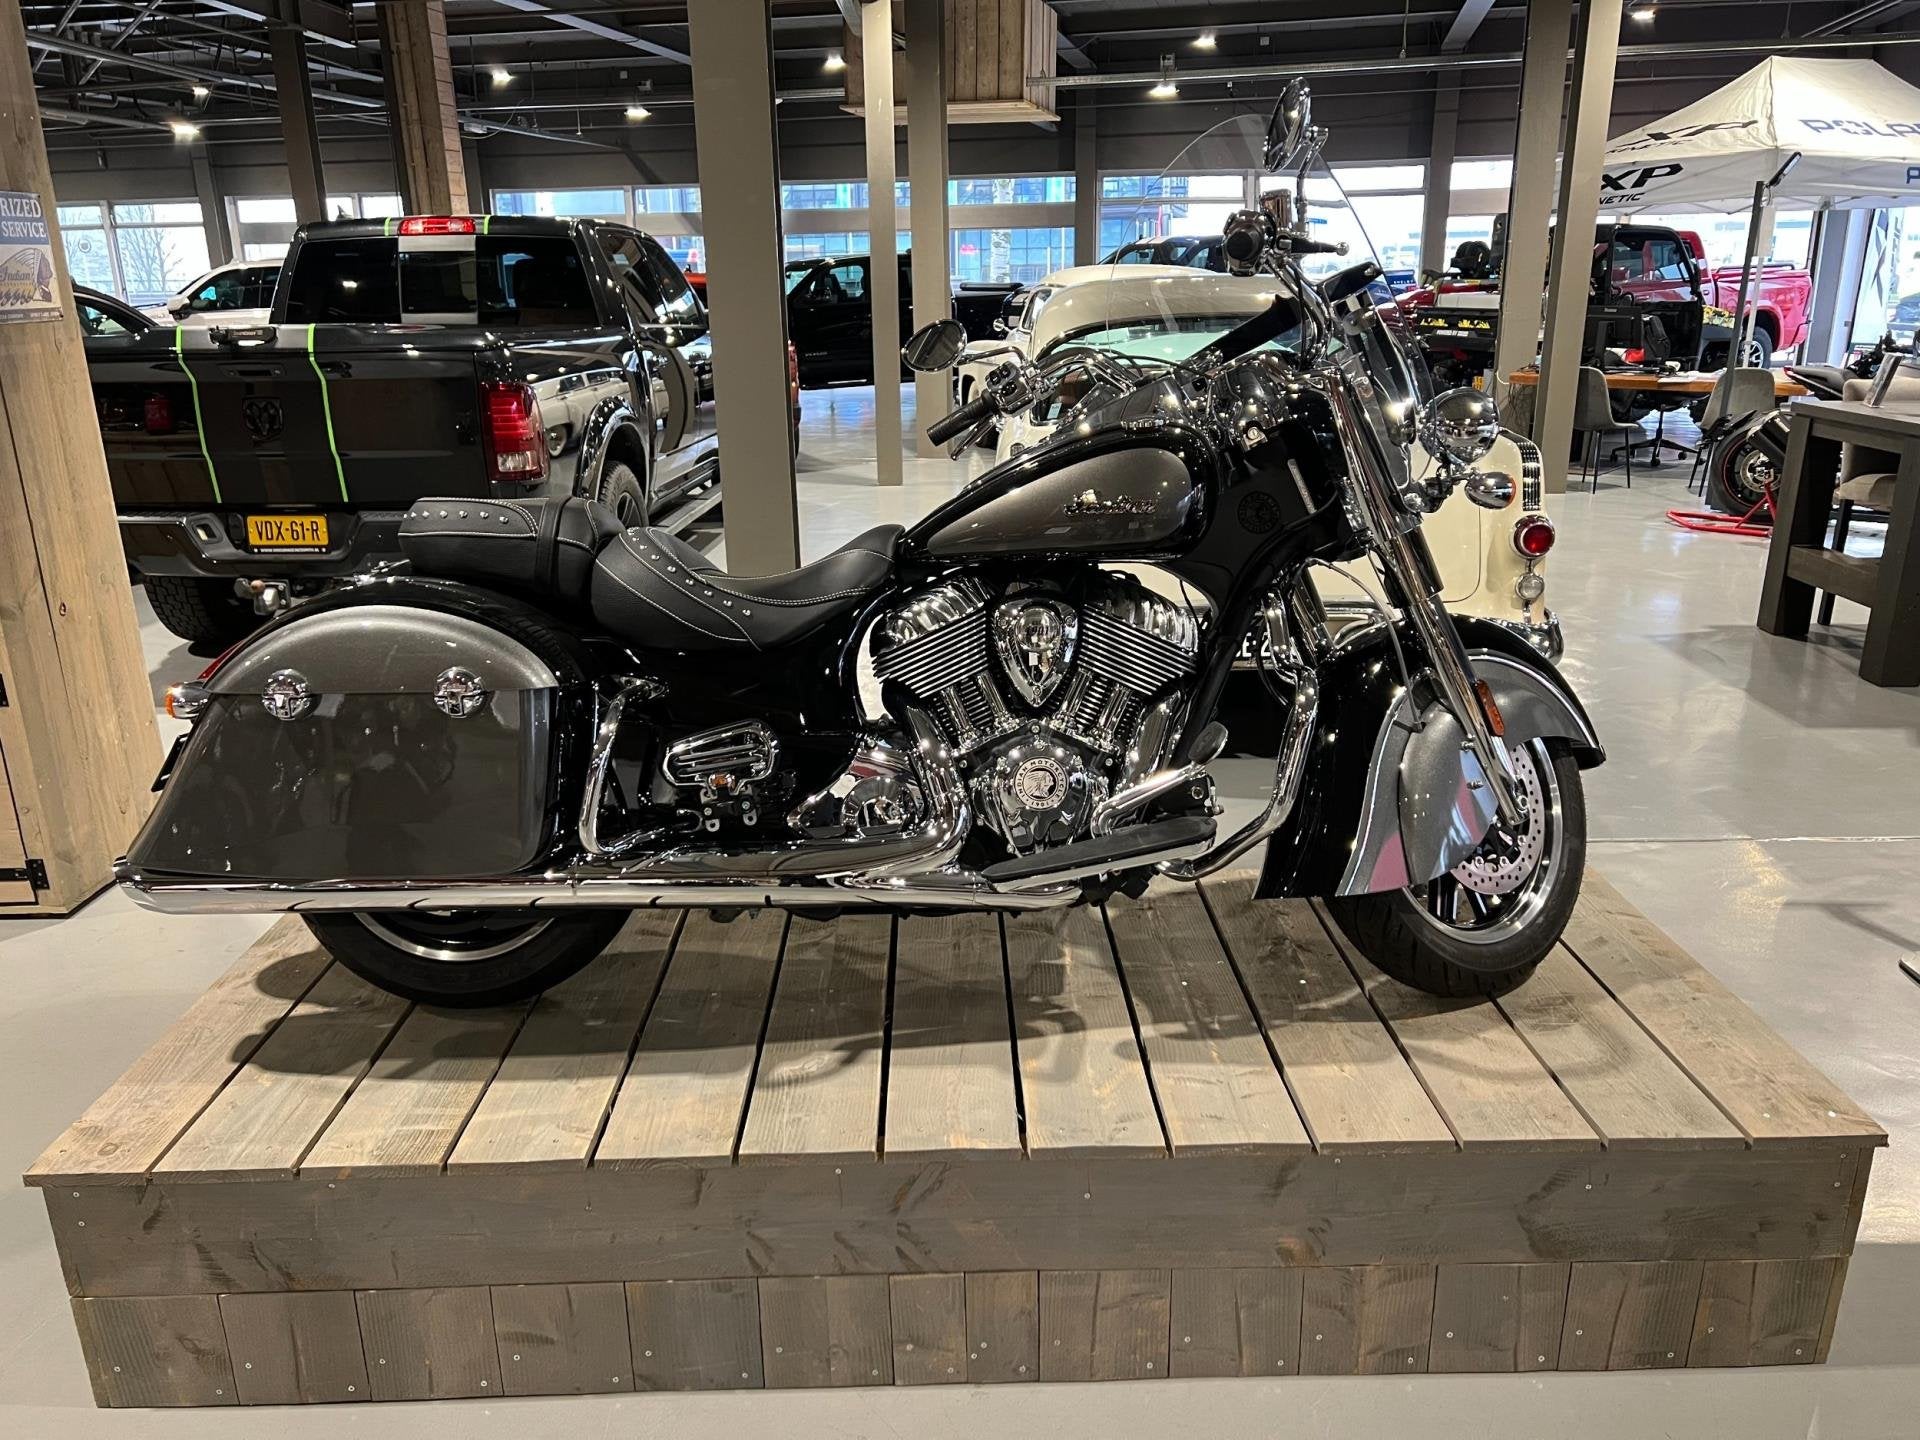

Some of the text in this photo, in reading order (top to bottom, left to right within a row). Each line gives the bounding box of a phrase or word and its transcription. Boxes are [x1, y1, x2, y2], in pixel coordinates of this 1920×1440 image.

[1798, 119, 1920, 137] POLA
[1601, 164, 1684, 191] XP
[0, 199, 42, 218] RIZED
[2, 221, 47, 238] SERVICE
[255, 520, 321, 541] VDX-61-R
[1017, 759, 1065, 798] INDIAN MOTORCYCLE
